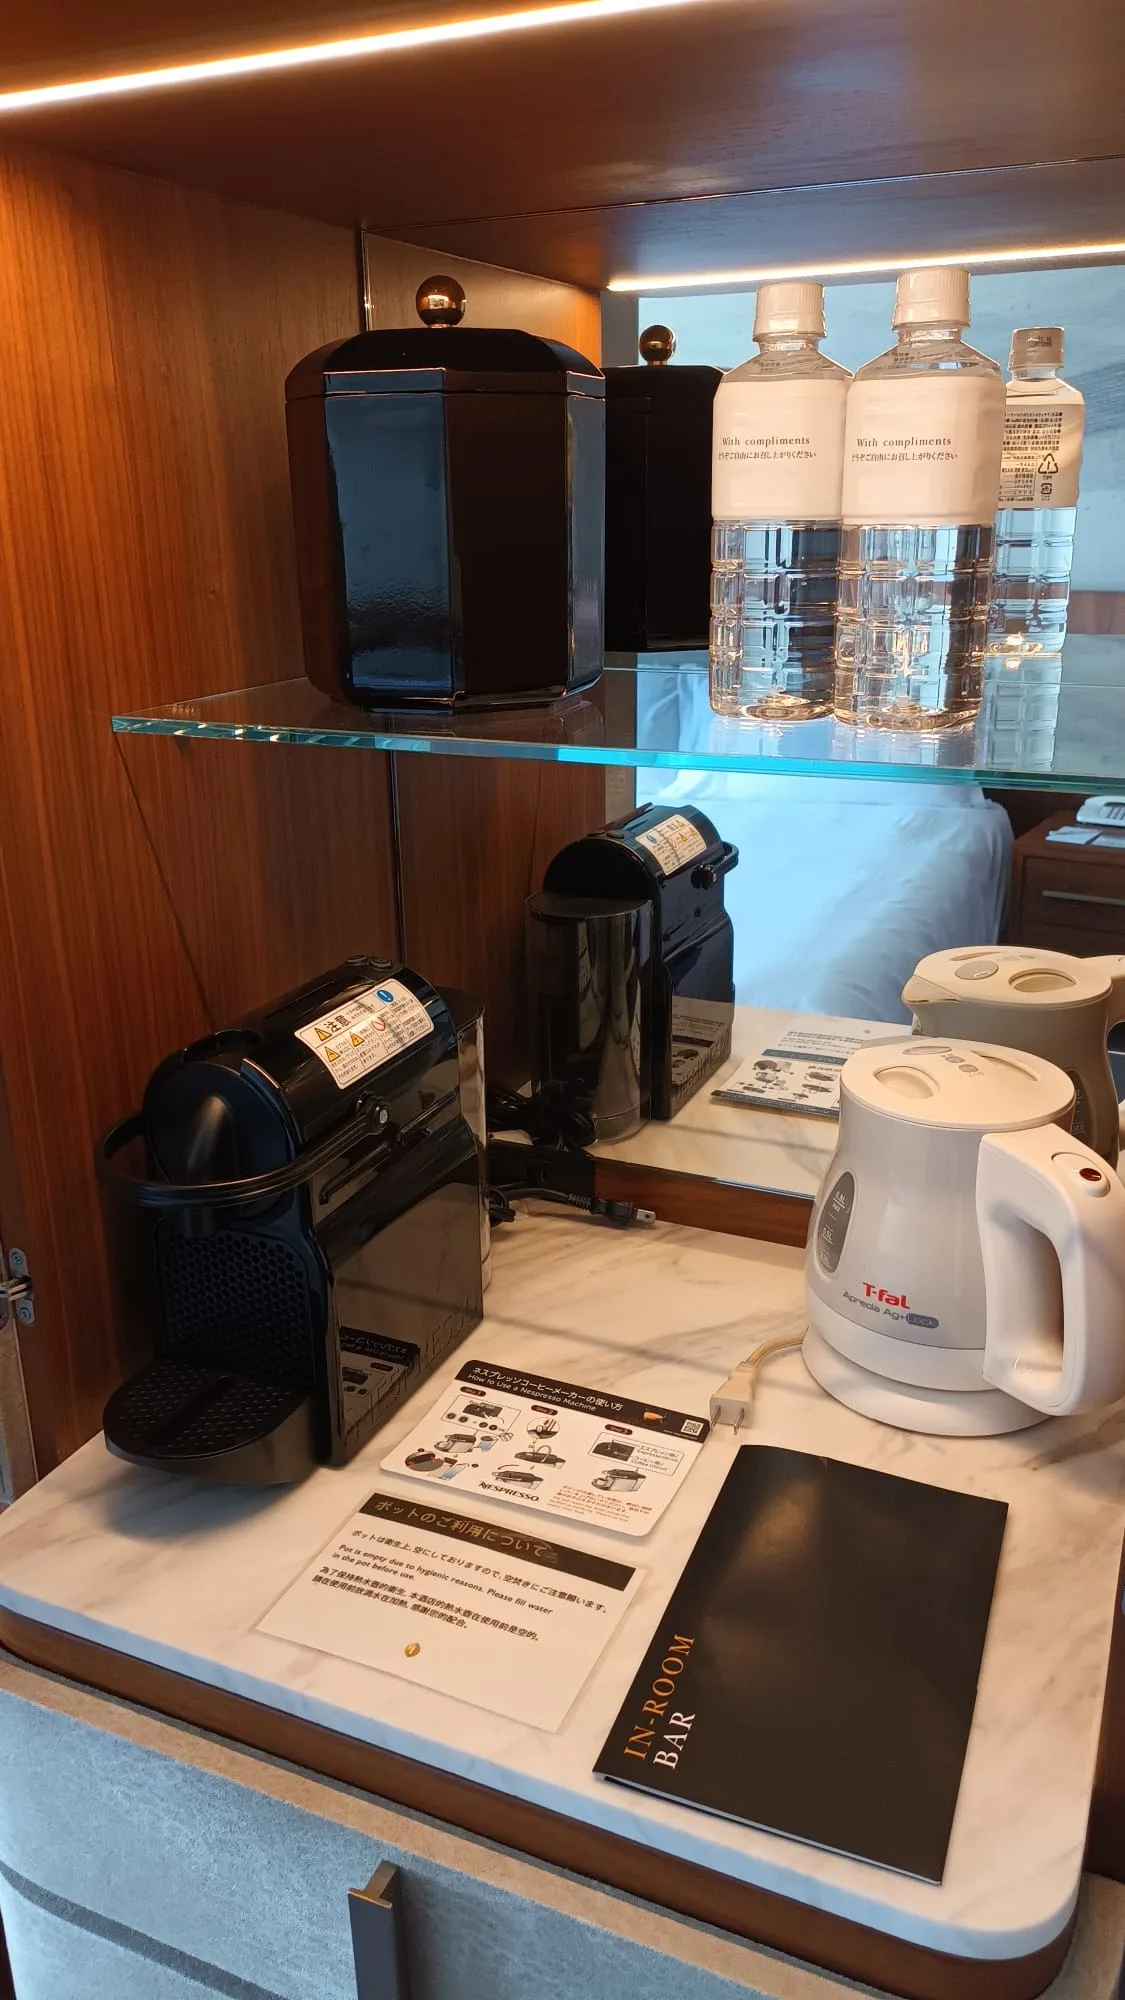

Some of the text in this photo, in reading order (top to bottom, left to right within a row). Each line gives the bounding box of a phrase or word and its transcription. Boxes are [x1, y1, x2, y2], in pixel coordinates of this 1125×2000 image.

[722, 436, 810, 448] With compliments
[856, 436, 951, 449] With compliments
[323, 1014, 350, 1033] 注意
[842, 1291, 880, 1313] Aprecia
[862, 1281, 910, 1309] T-fal
[467, 1373, 486, 1383] How
[497, 1381, 511, 1389] Use
[520, 1387, 562, 1402] Nespresso
[562, 1398, 597, 1411] Machine
[472, 1367, 624, 1411] ネスプレッソコーヒーメーカーの使い方
[478, 1482, 540, 1502] NESPRESSO
[374, 1500, 545, 1557] ポットのご利用について
[338, 1544, 354, 1554] Pot
[362, 1552, 387, 1563] empty
[389, 1558, 404, 1567] due
[416, 1566, 450, 1581] hygienic
[451, 1577, 484, 1593] reasons.
[486, 1588, 513, 1602] Please
[514, 1598, 527, 1607] fill
[528, 1604, 554, 1614] water
[341, 1554, 355, 1563] the
[355, 1559, 370, 1568] pot
[371, 1562, 398, 1575] before
[399, 1572, 415, 1581] use.
[623, 1633, 696, 1760] IN-ROOM
[652, 1711, 696, 1770] BAR
